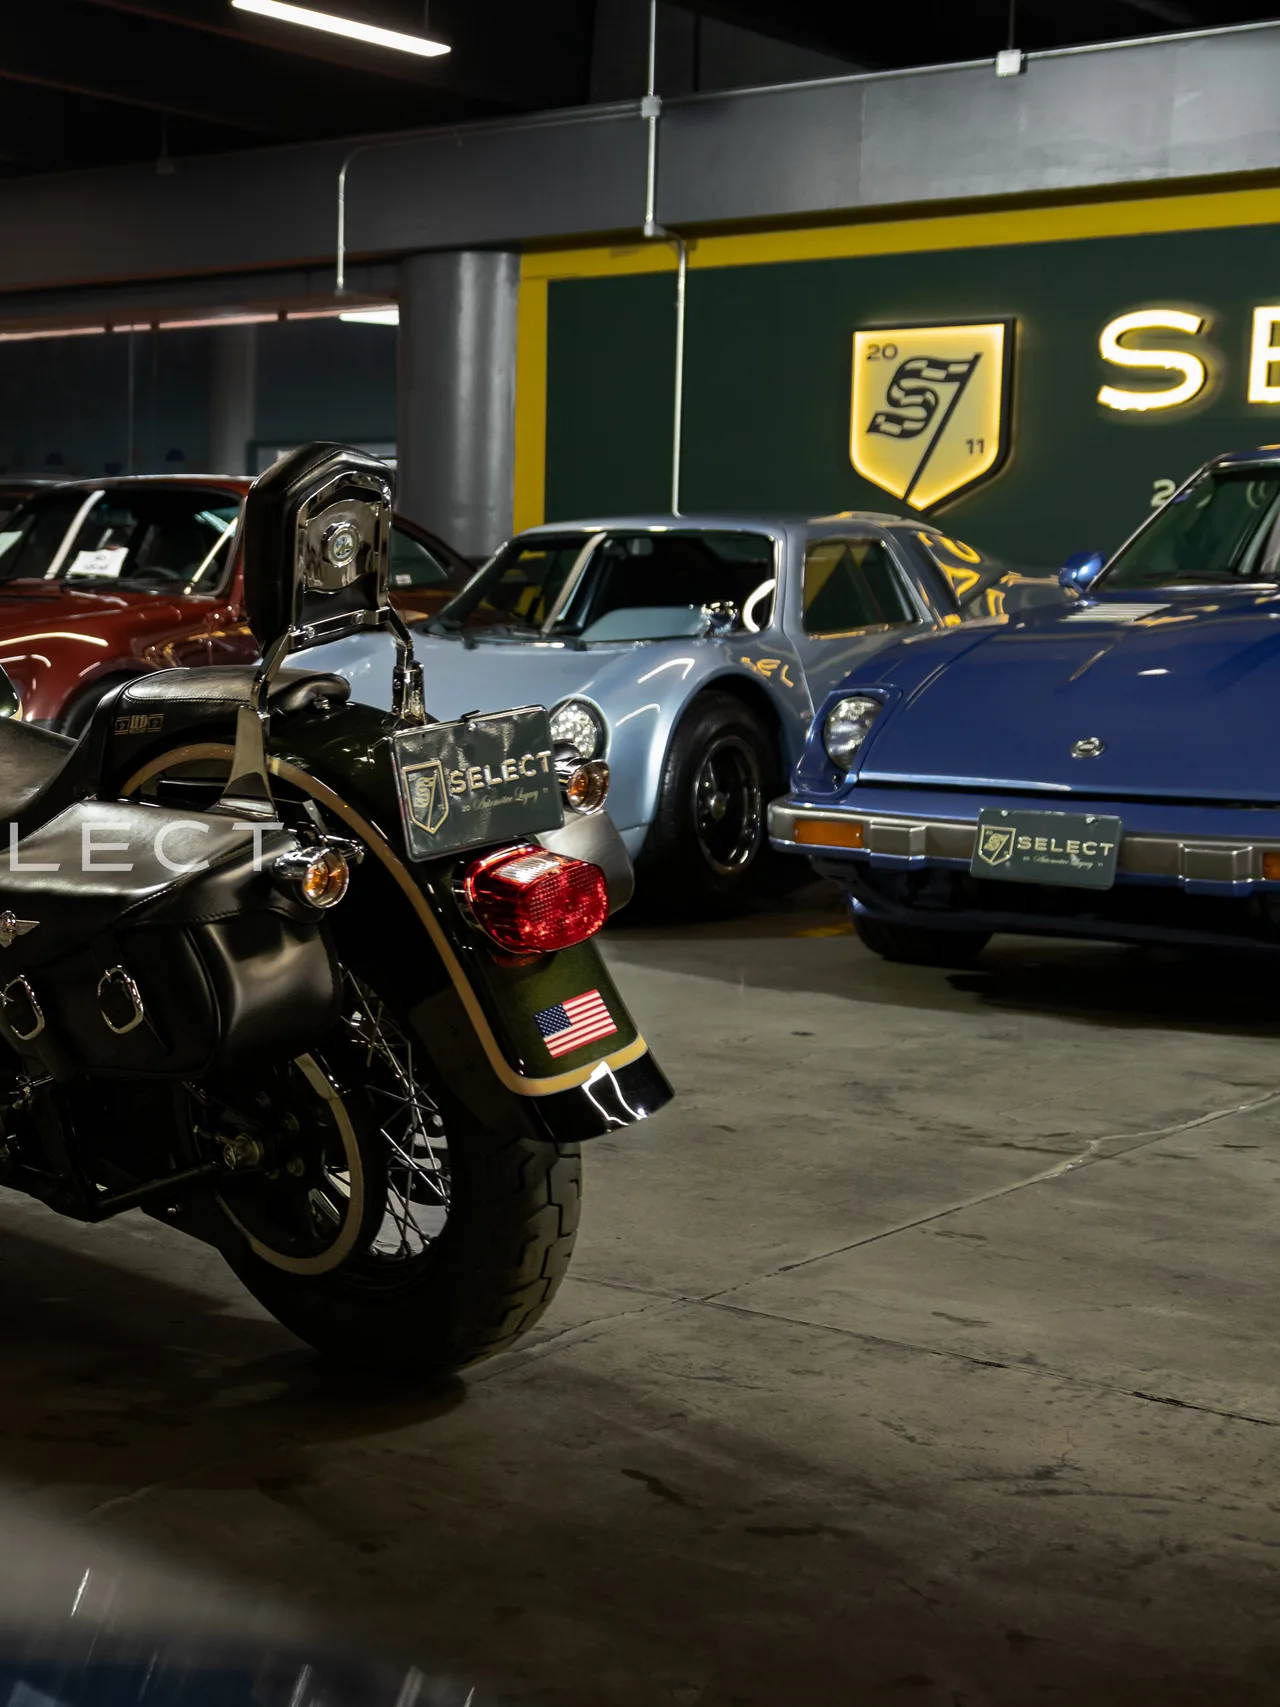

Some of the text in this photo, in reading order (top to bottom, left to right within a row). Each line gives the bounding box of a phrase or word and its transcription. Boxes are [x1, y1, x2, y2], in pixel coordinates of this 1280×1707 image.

[866, 343, 898, 360] 20
[966, 438, 985, 454] 11
[450, 750, 552, 794] SELECT
[1017, 836, 1114, 857] SELECT
